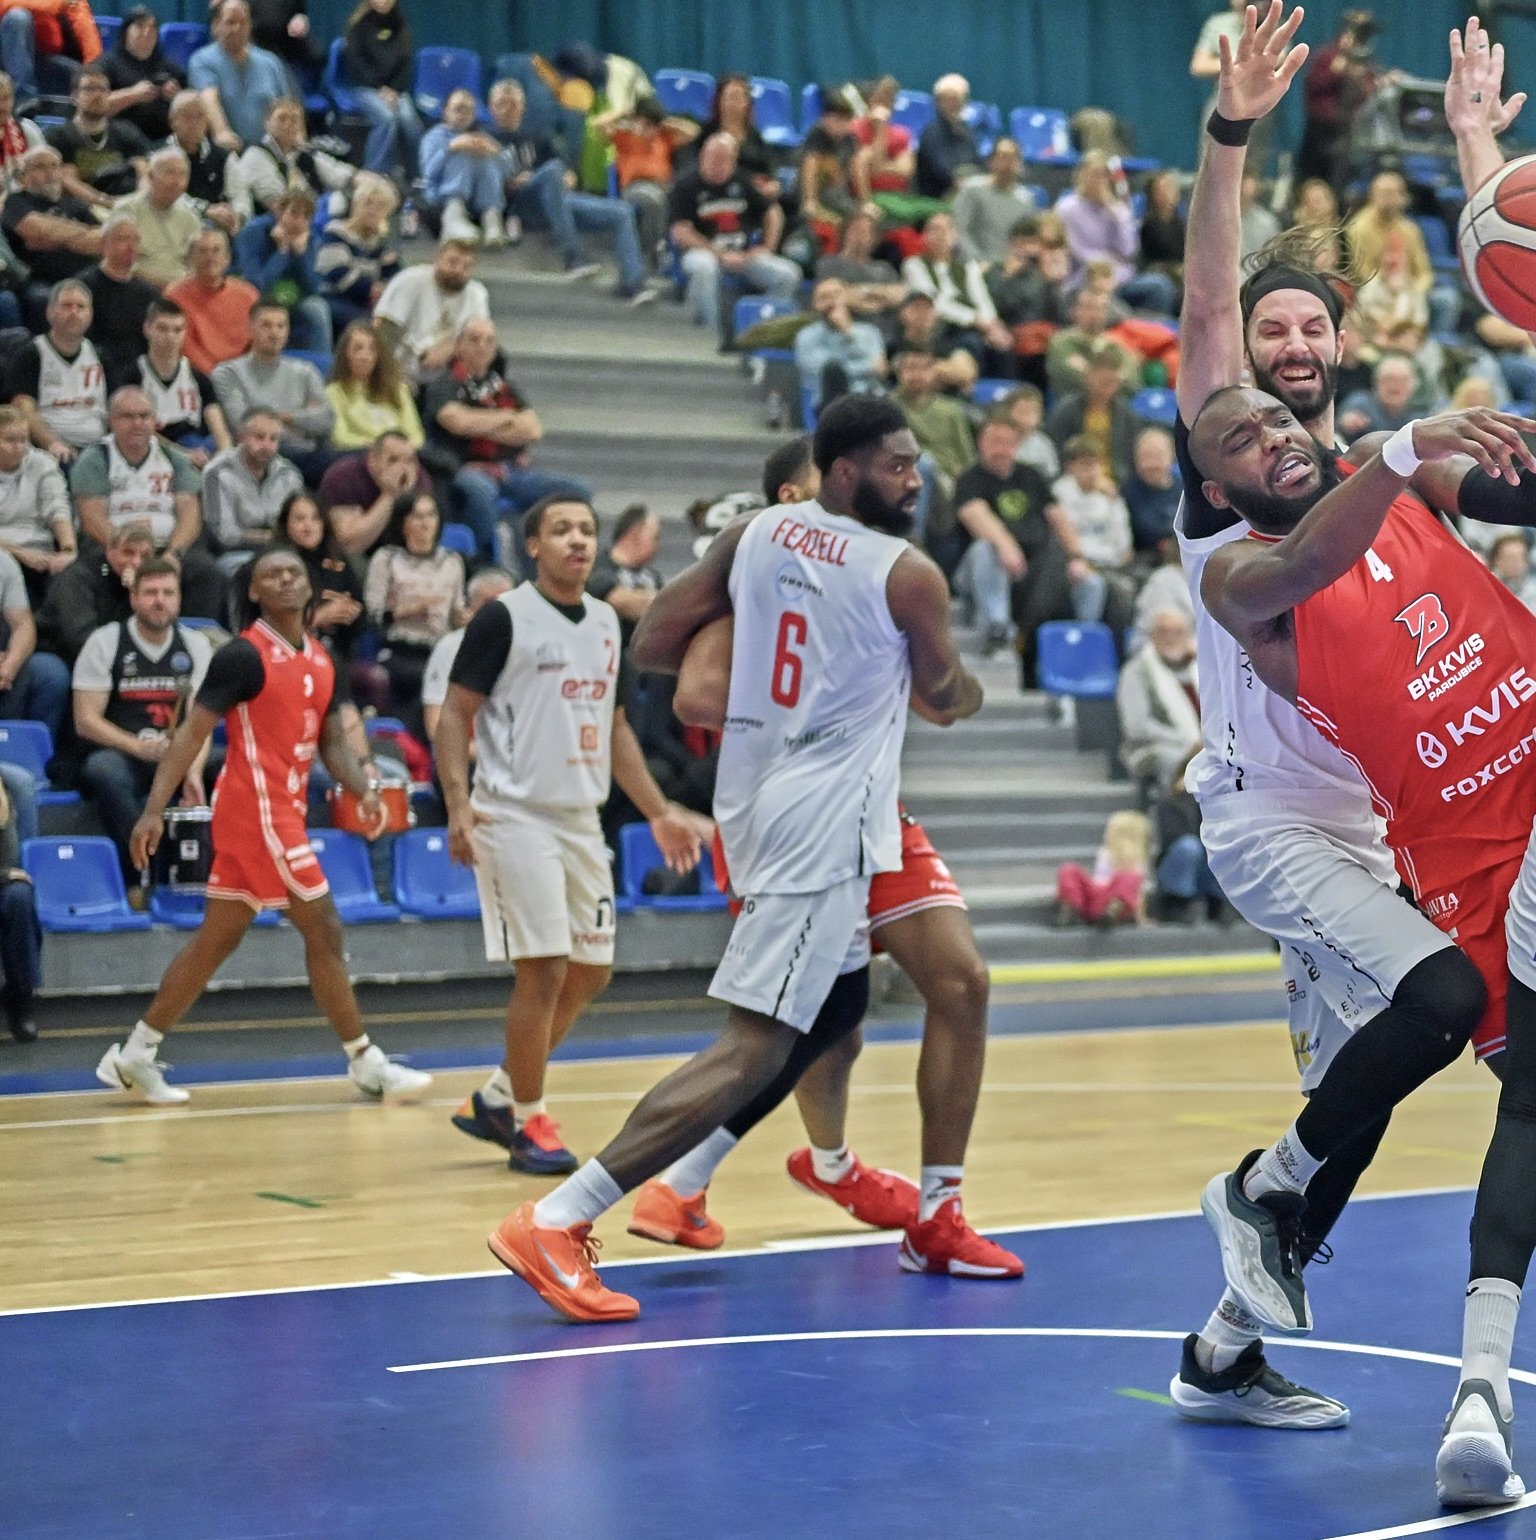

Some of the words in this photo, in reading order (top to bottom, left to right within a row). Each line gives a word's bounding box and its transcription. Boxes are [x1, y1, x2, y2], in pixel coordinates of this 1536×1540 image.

[770, 517, 849, 567] FEAZELL
[1364, 547, 1395, 583] 4
[770, 610, 809, 709] 6
[1407, 664, 1442, 701] BK
[1438, 632, 1486, 678] KVIS
[1427, 655, 1484, 703] PARDUBICE
